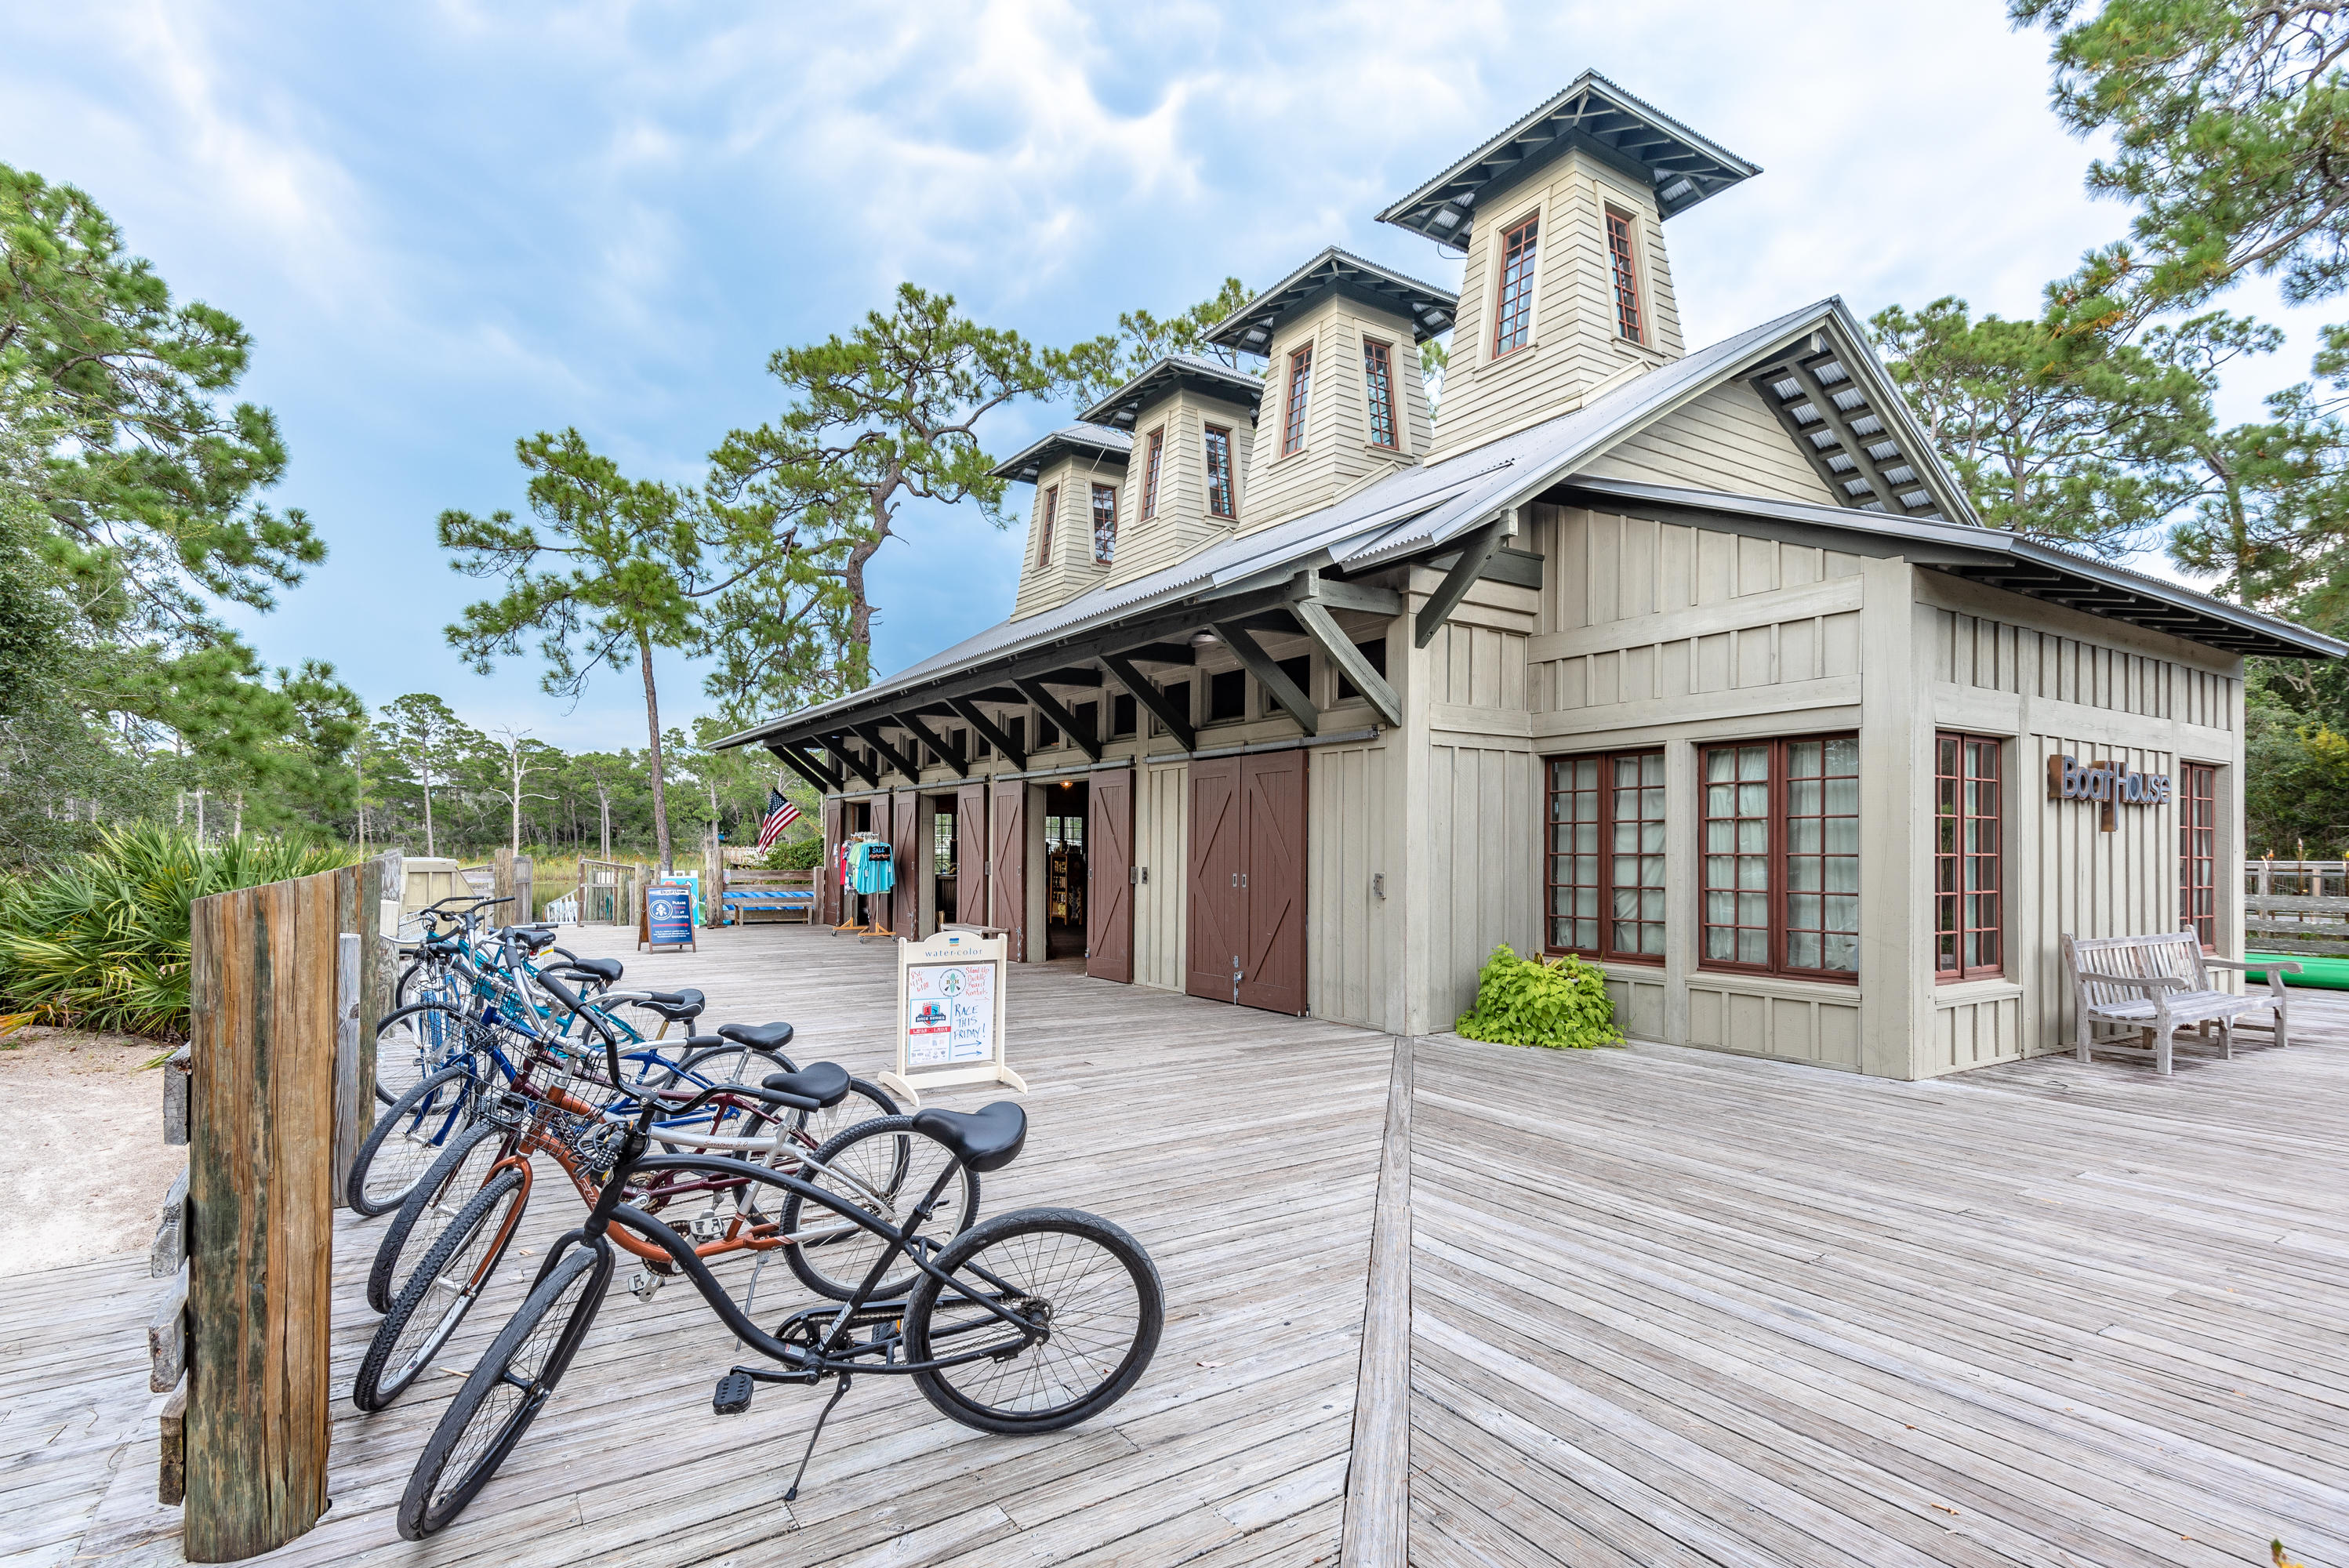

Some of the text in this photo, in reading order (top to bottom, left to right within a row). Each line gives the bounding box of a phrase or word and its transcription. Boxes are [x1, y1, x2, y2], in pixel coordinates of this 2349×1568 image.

[954, 1003, 978, 1017] RACE
[956, 1016, 978, 1028] THIS
[953, 1022, 986, 1040] FRIDAY!
